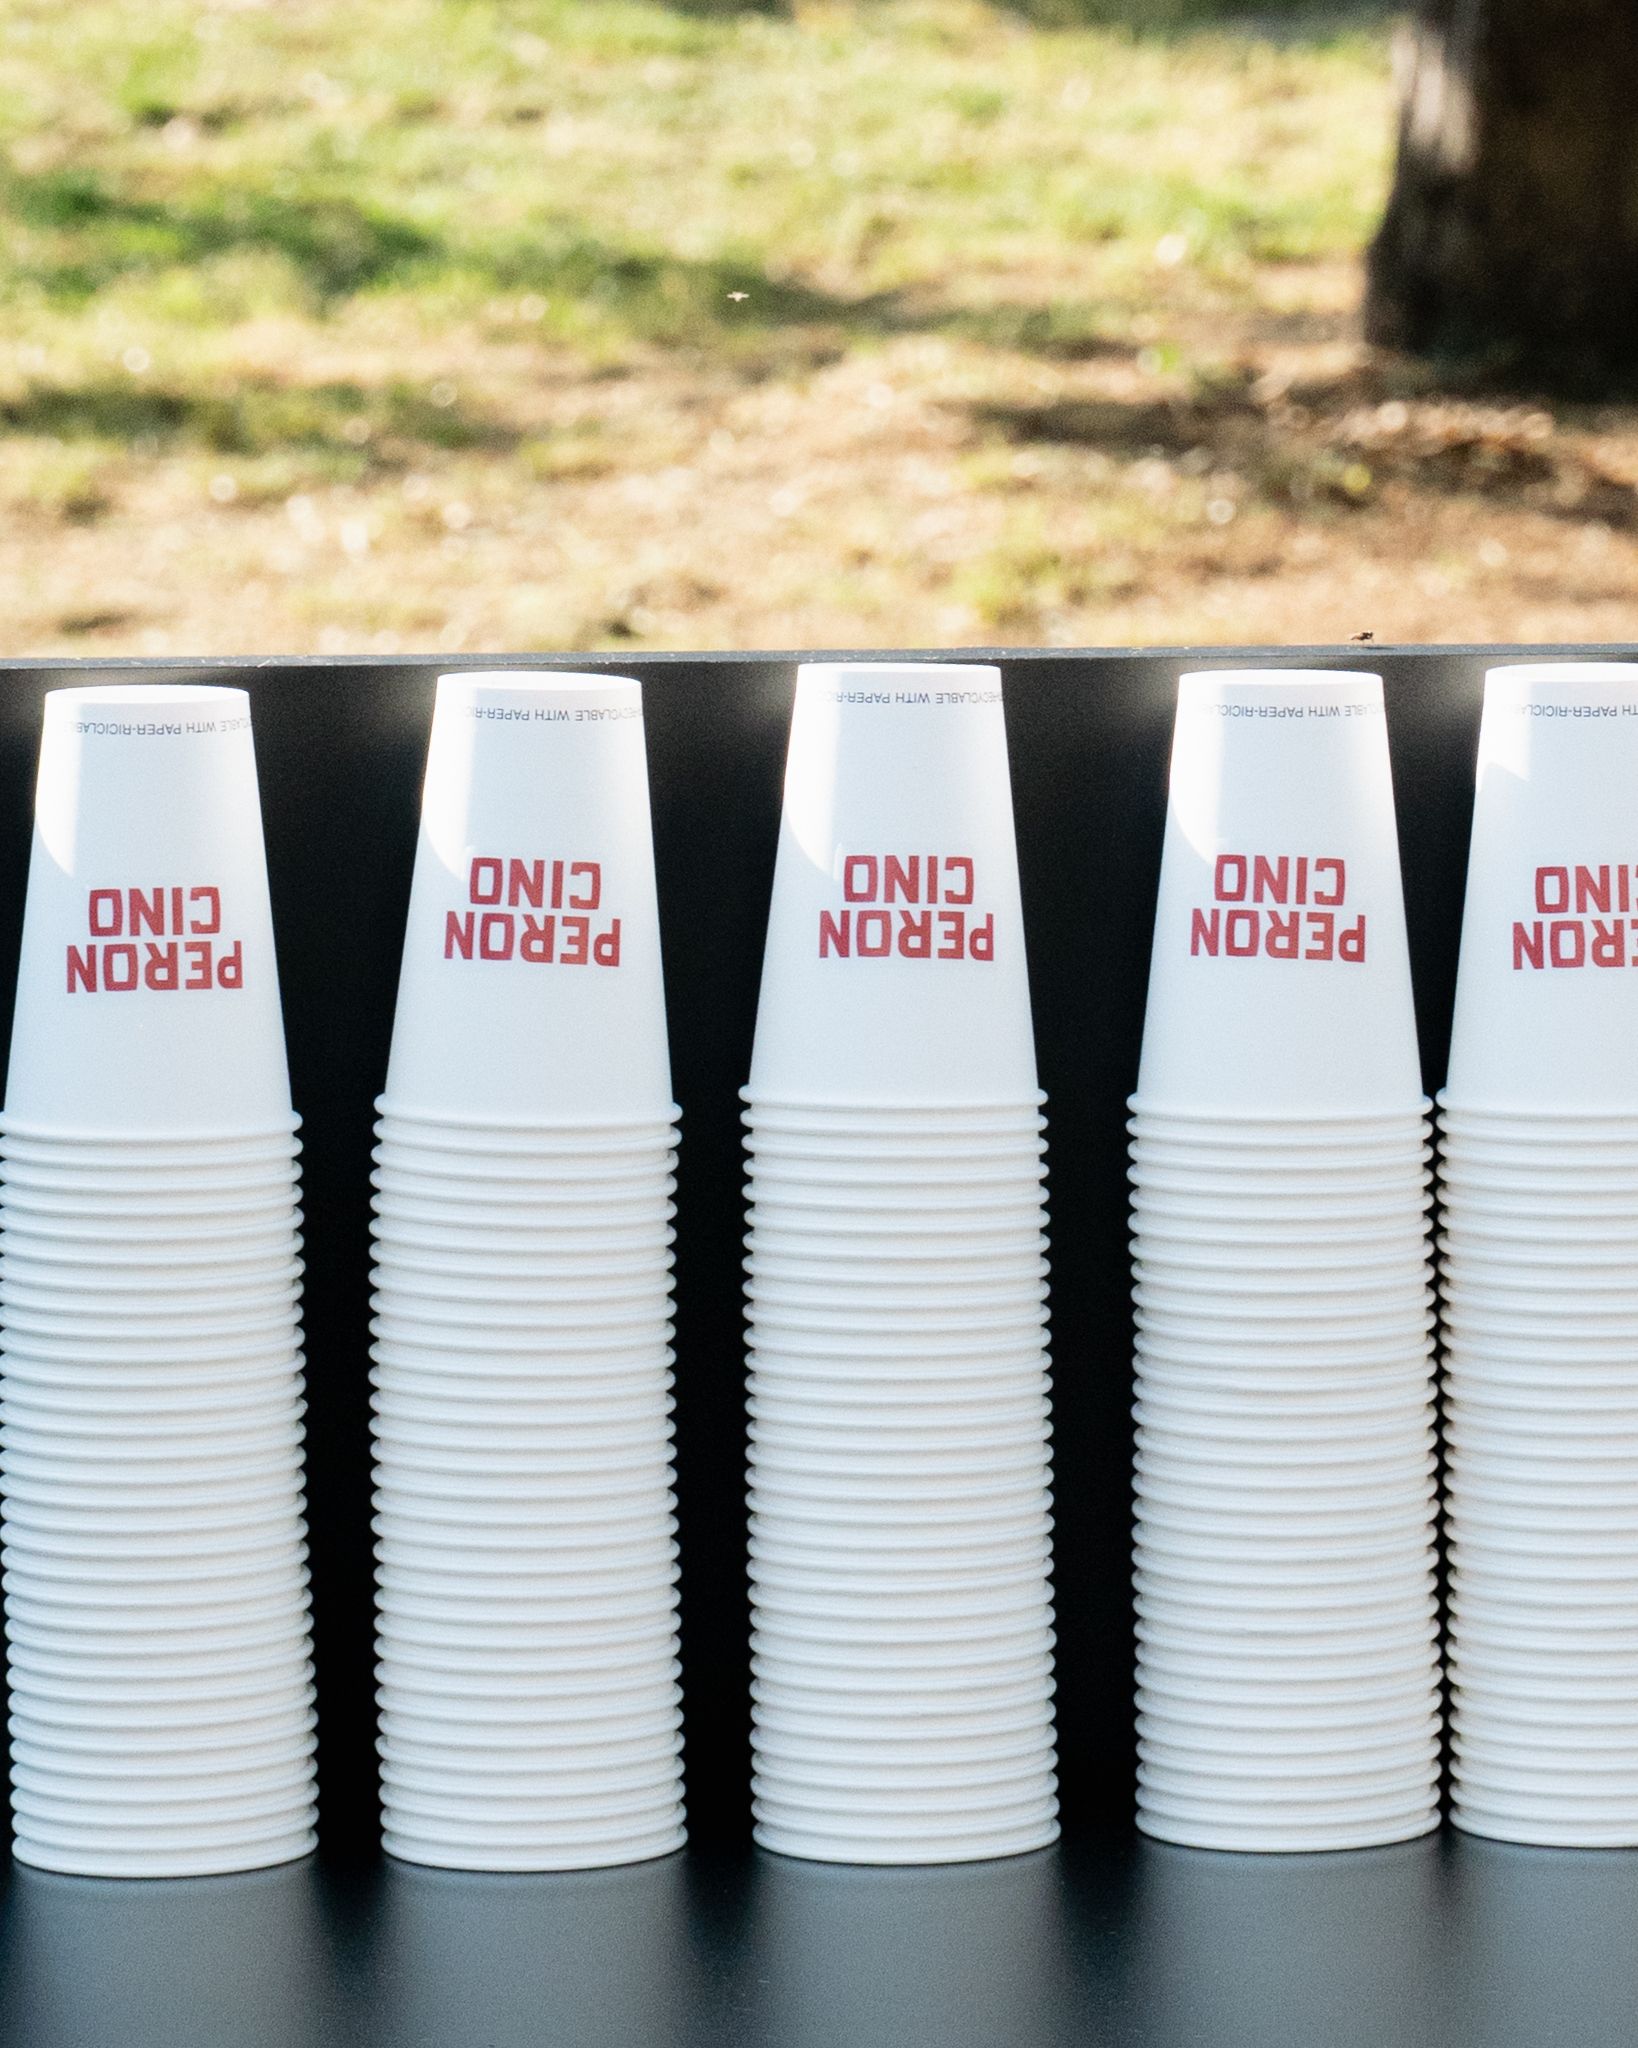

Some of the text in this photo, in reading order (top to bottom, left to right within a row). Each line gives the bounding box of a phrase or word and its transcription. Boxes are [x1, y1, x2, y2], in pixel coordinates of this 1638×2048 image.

[534, 709, 570, 721] WITH
[895, 692, 930, 704] WITH
[1308, 704, 1341, 718] WITH
[186, 721, 216, 734] WITH
[471, 858, 600, 909] CINO
[845, 856, 973, 904] CINO
[1215, 855, 1345, 905] CINO
[1536, 865, 1638, 913] INO
[89, 887, 220, 935] CINO
[446, 912, 620, 966] PERON
[820, 911, 993, 961] PERON
[1192, 909, 1365, 962] PERON
[1513, 919, 1638, 968] RON
[68, 941, 243, 992] PERON
